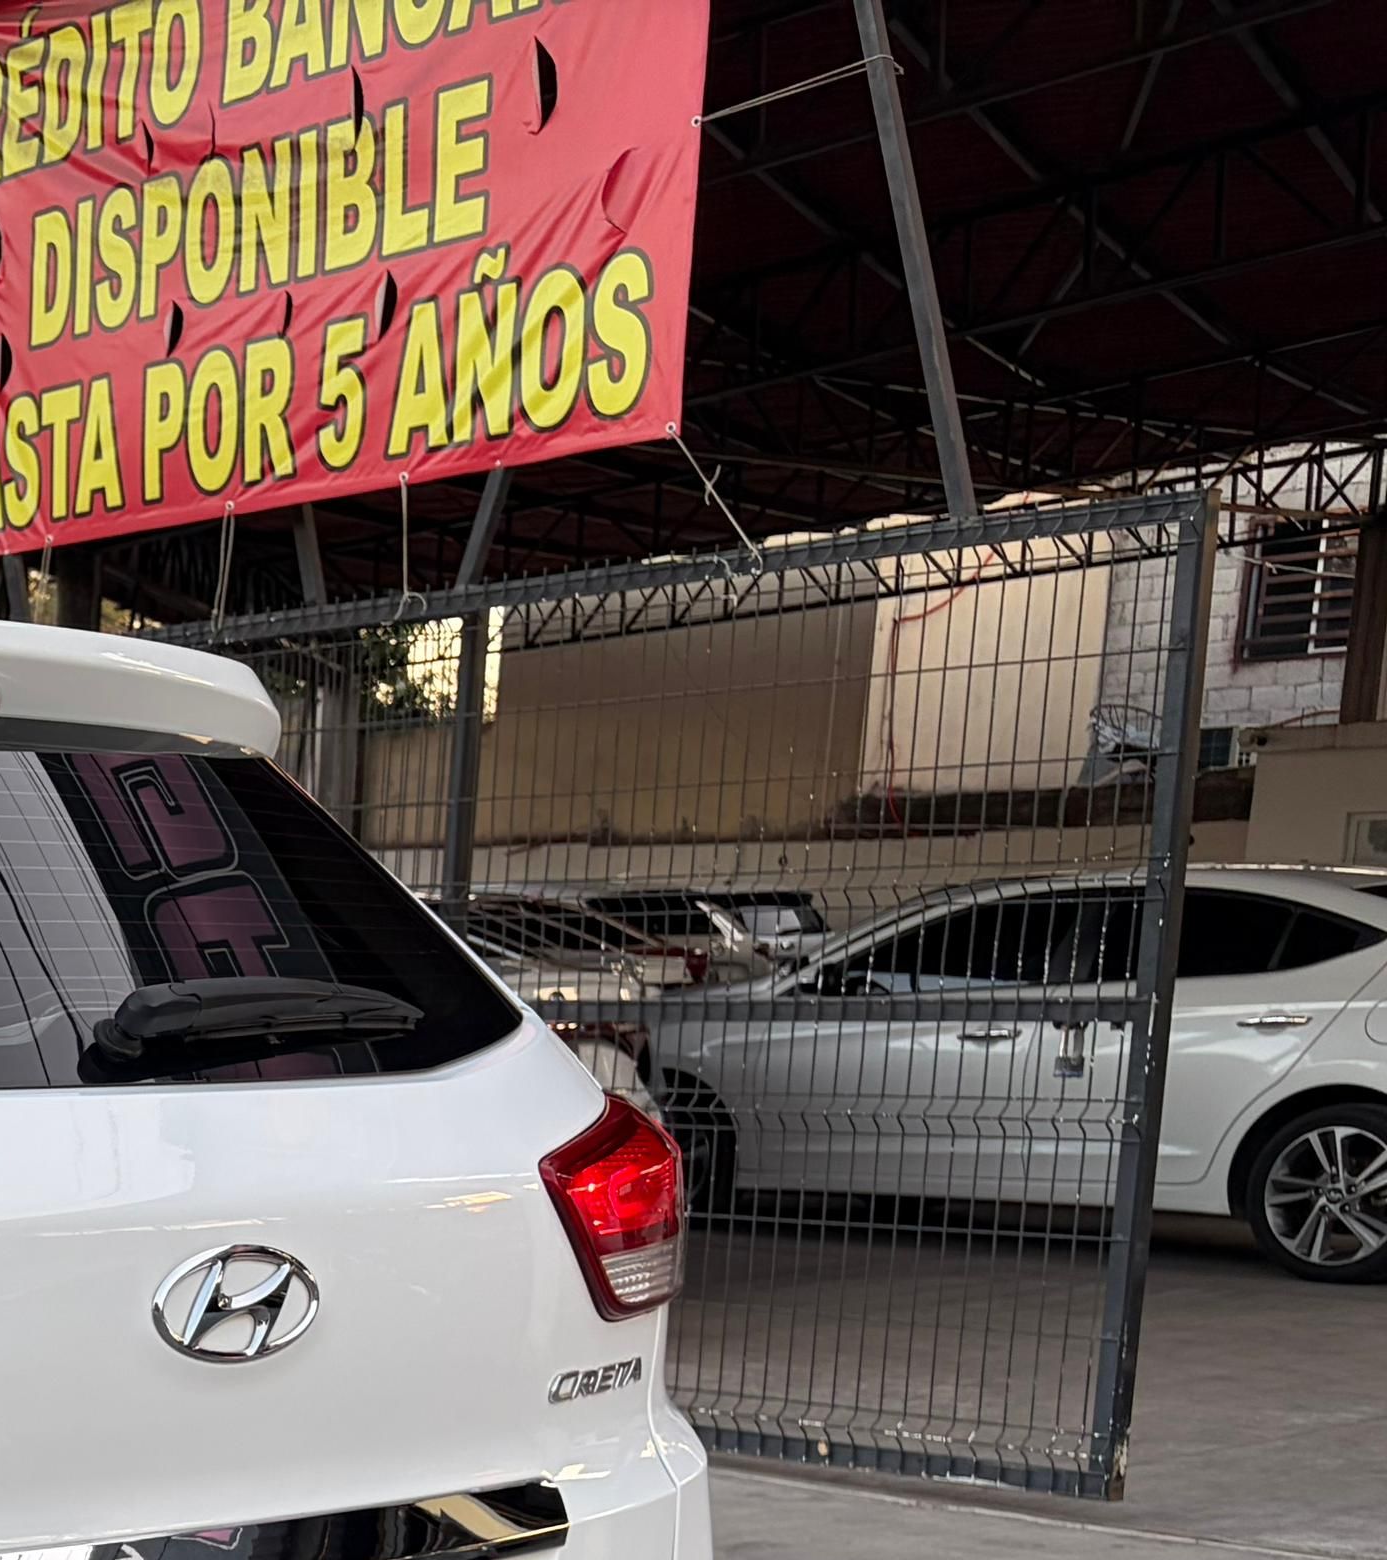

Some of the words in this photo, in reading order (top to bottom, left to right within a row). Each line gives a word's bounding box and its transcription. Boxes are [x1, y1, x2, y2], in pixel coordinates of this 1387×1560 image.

[28, 75, 493, 350] DISPONIBLE
[142, 331, 296, 502] POR
[317, 312, 367, 471] 5
[385, 244, 654, 461] AÑOS
[547, 1356, 643, 1404] CRETA
